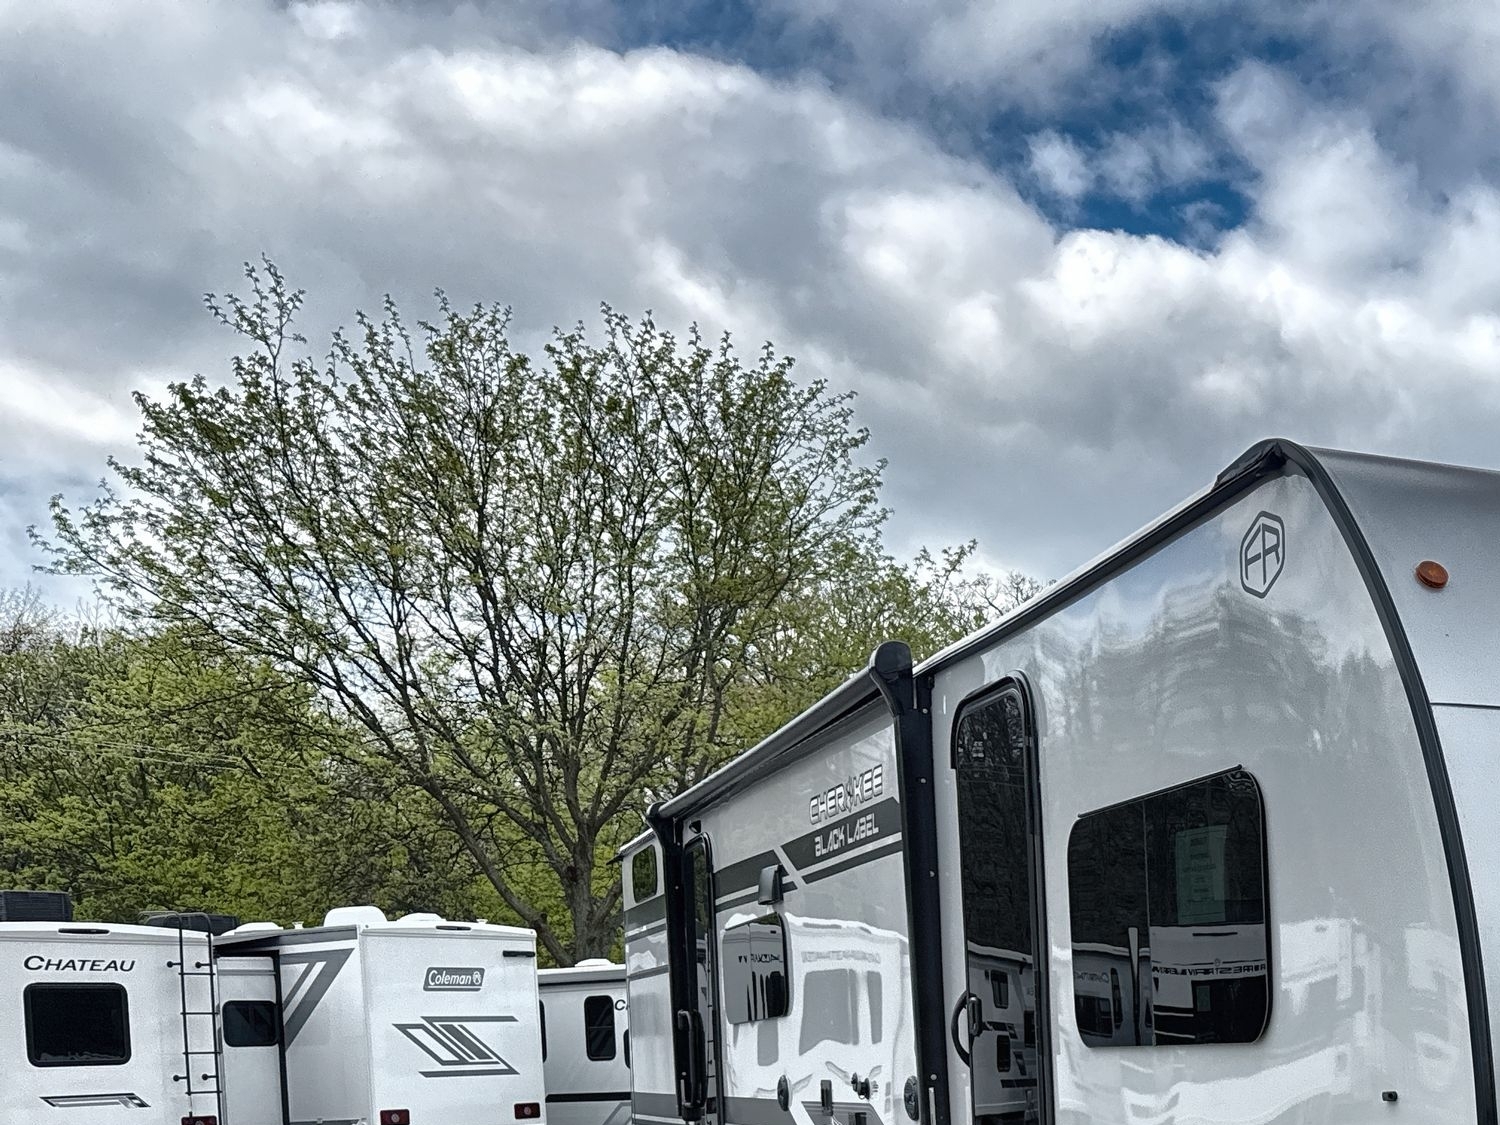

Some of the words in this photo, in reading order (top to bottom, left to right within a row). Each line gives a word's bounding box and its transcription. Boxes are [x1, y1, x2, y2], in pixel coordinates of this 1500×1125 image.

[815, 826, 844, 857] BLACK
[847, 813, 879, 844] LABEL
[23, 955, 136, 973] CHATEAU
[428, 969, 472, 986] Coleman
